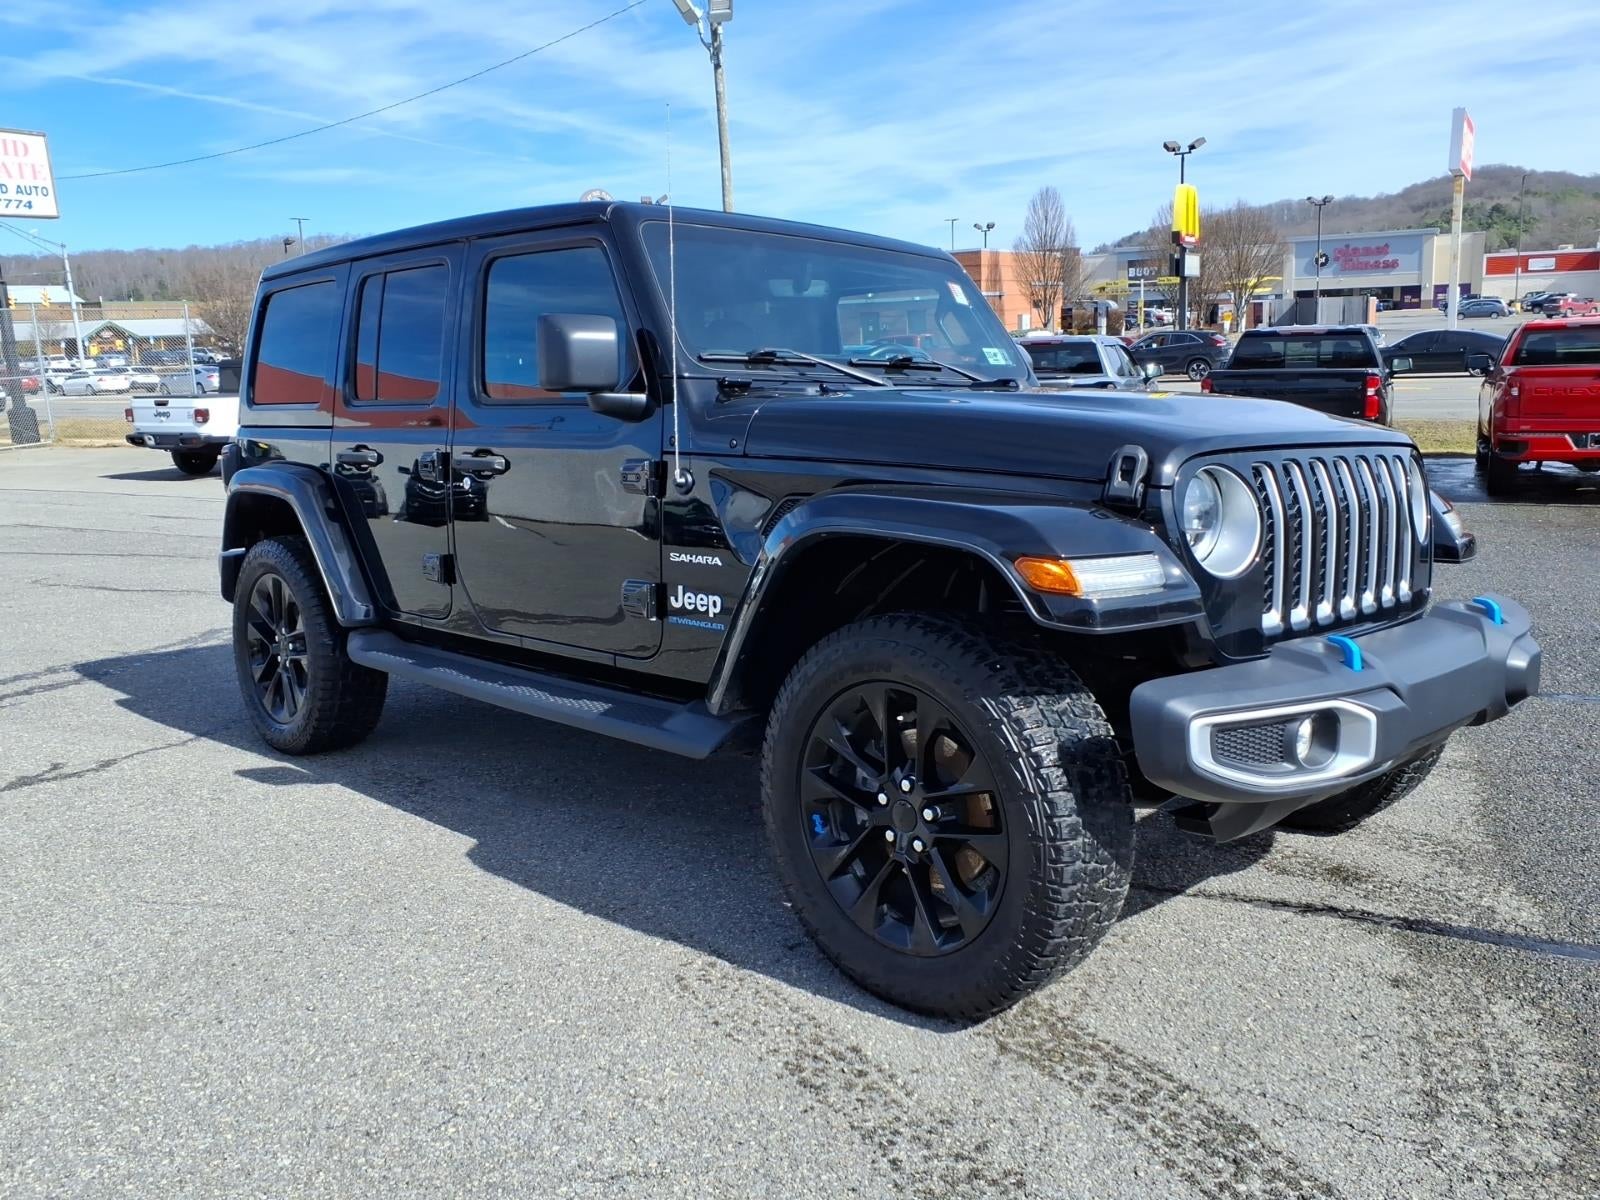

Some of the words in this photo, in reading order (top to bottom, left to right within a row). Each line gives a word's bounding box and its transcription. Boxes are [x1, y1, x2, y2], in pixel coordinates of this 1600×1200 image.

[16, 184, 49, 197] AUTO
[0, 198, 33, 210] 774
[154, 408, 171, 418] Jeep
[669, 552, 722, 566] SAHARA
[670, 585, 721, 617] Jeep
